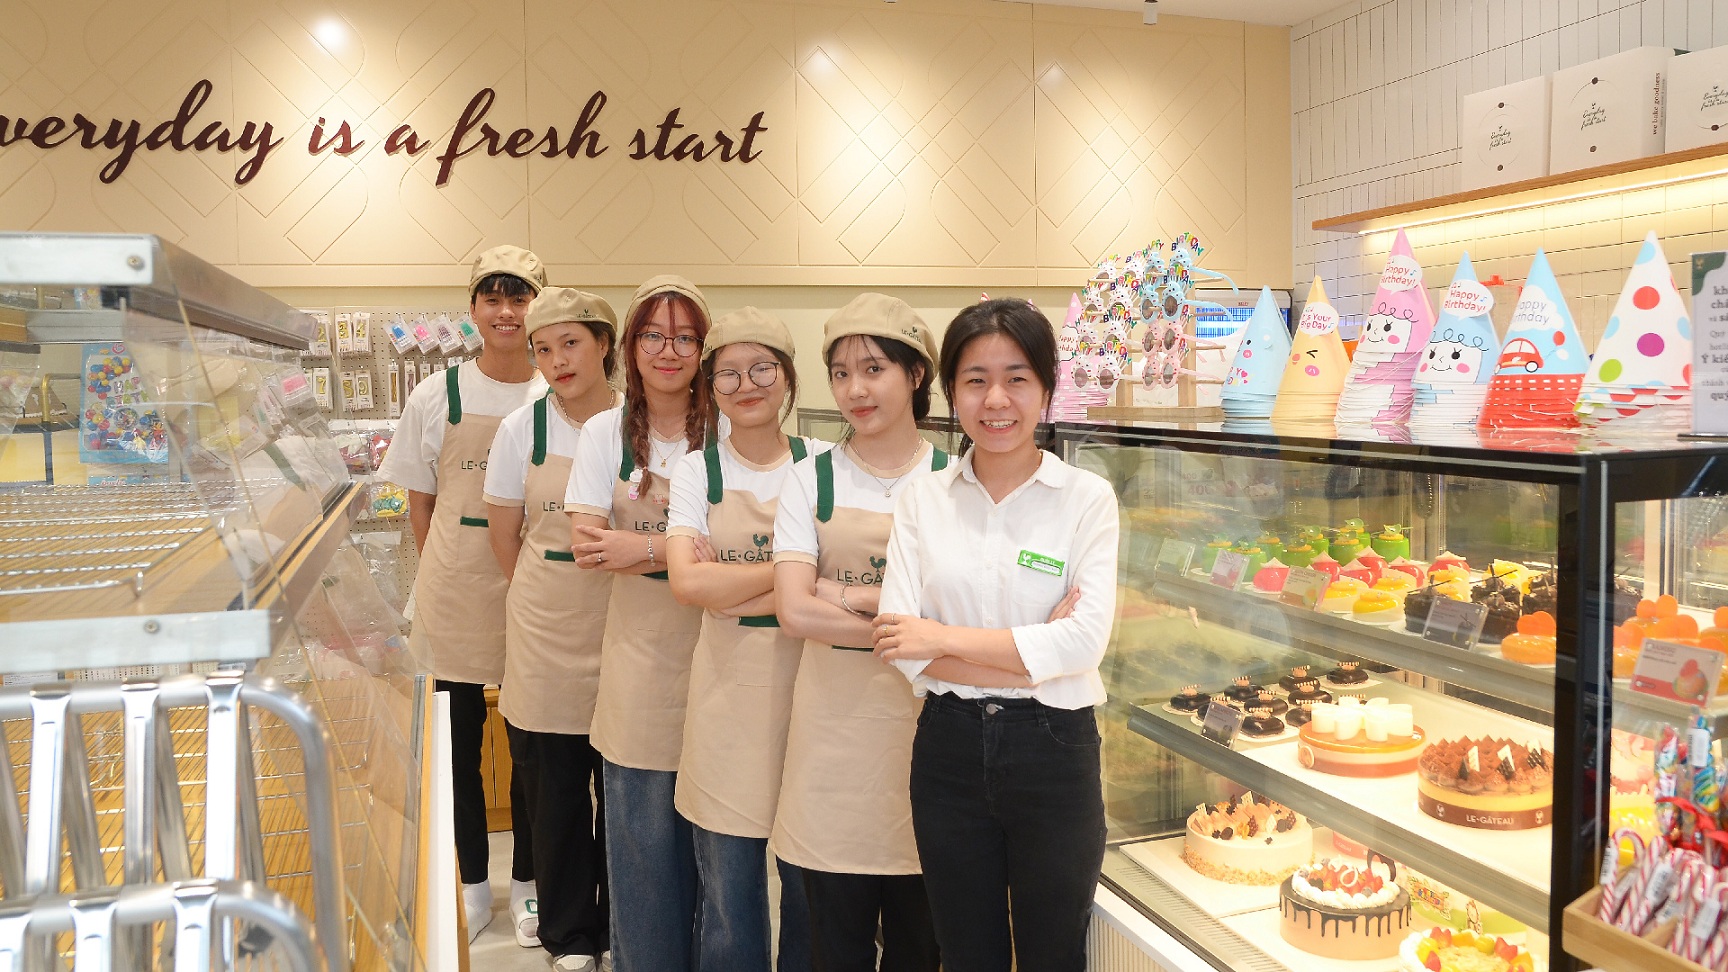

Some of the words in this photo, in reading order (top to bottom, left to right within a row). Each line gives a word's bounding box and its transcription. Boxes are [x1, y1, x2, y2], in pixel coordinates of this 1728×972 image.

[1653, 72, 1661, 105] goodness
[1652, 125, 1658, 135] we
[308, 116, 365, 155] is
[384, 124, 431, 155] a
[436, 87, 609, 187] fresh
[628, 107, 769, 164] start
[1450, 290, 1480, 301] Happy
[1518, 300, 1547, 312] appy
[1312, 320, 1328, 331] Day
[316, 377, 327, 395] 7
